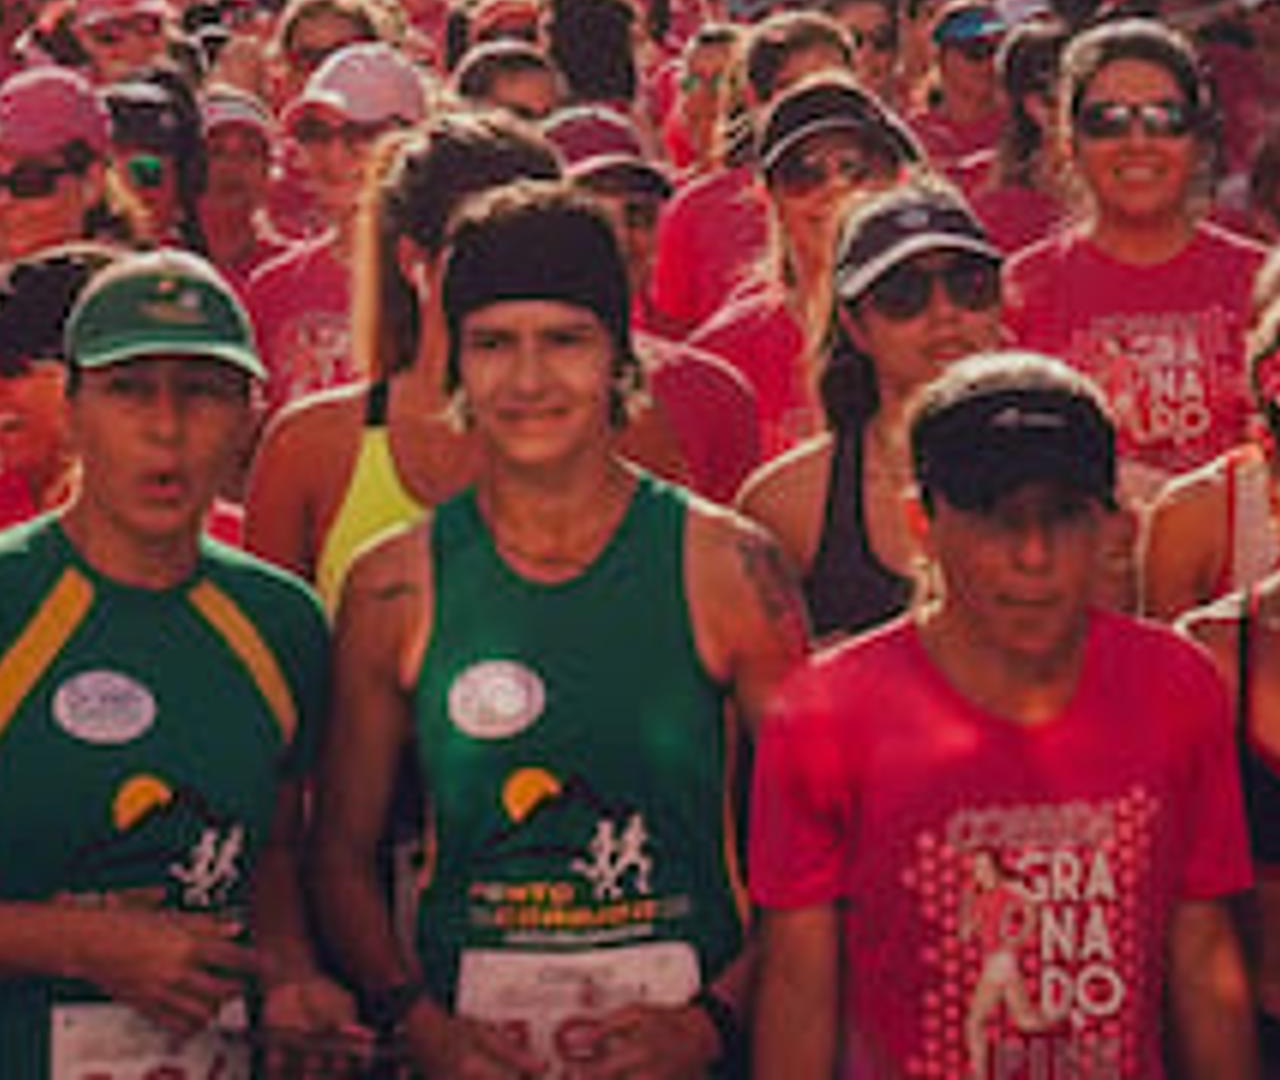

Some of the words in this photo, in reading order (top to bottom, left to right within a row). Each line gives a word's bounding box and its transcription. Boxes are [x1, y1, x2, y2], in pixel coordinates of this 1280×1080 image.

[1017, 849, 1118, 902] GRA
[1040, 905, 1113, 962] NA
[1040, 964, 1126, 1022] DO
